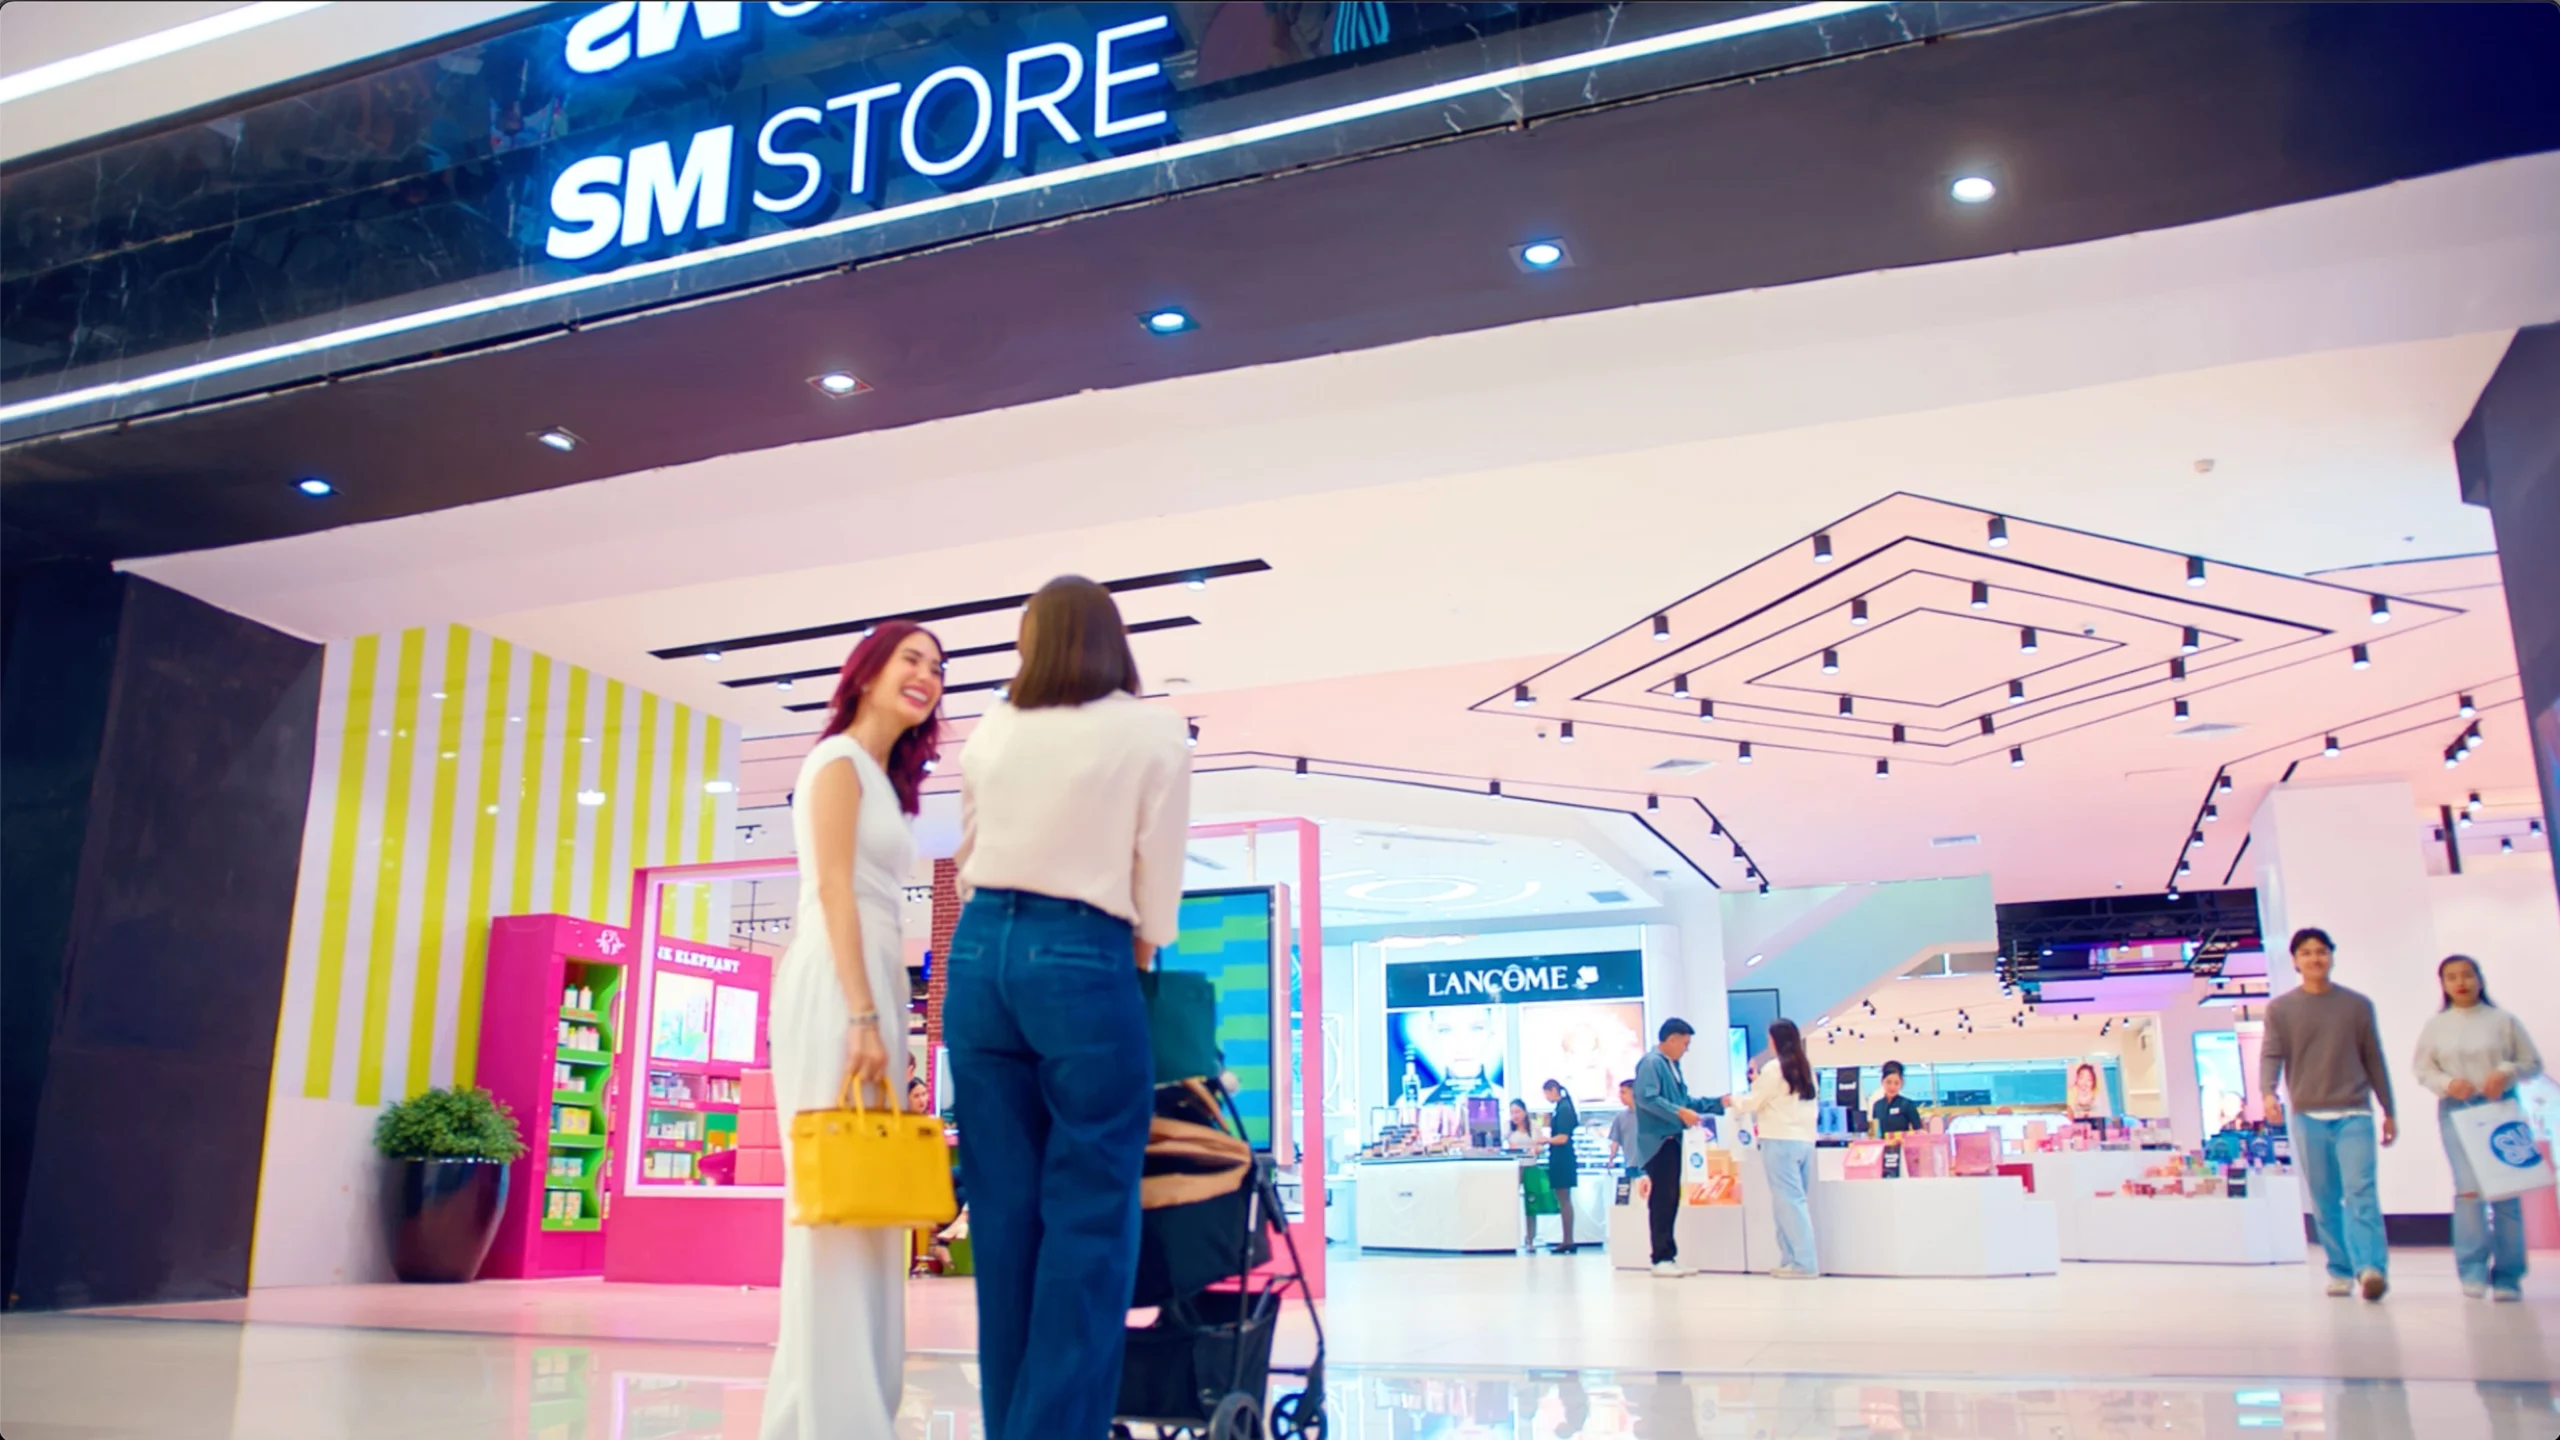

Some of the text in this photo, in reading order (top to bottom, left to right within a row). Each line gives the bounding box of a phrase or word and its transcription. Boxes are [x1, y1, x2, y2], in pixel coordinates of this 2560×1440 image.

[546, 15, 1168, 260] SM STORE
[674, 949, 740, 974] ELEPHANT
[1428, 964, 1568, 996] LANCÔME
